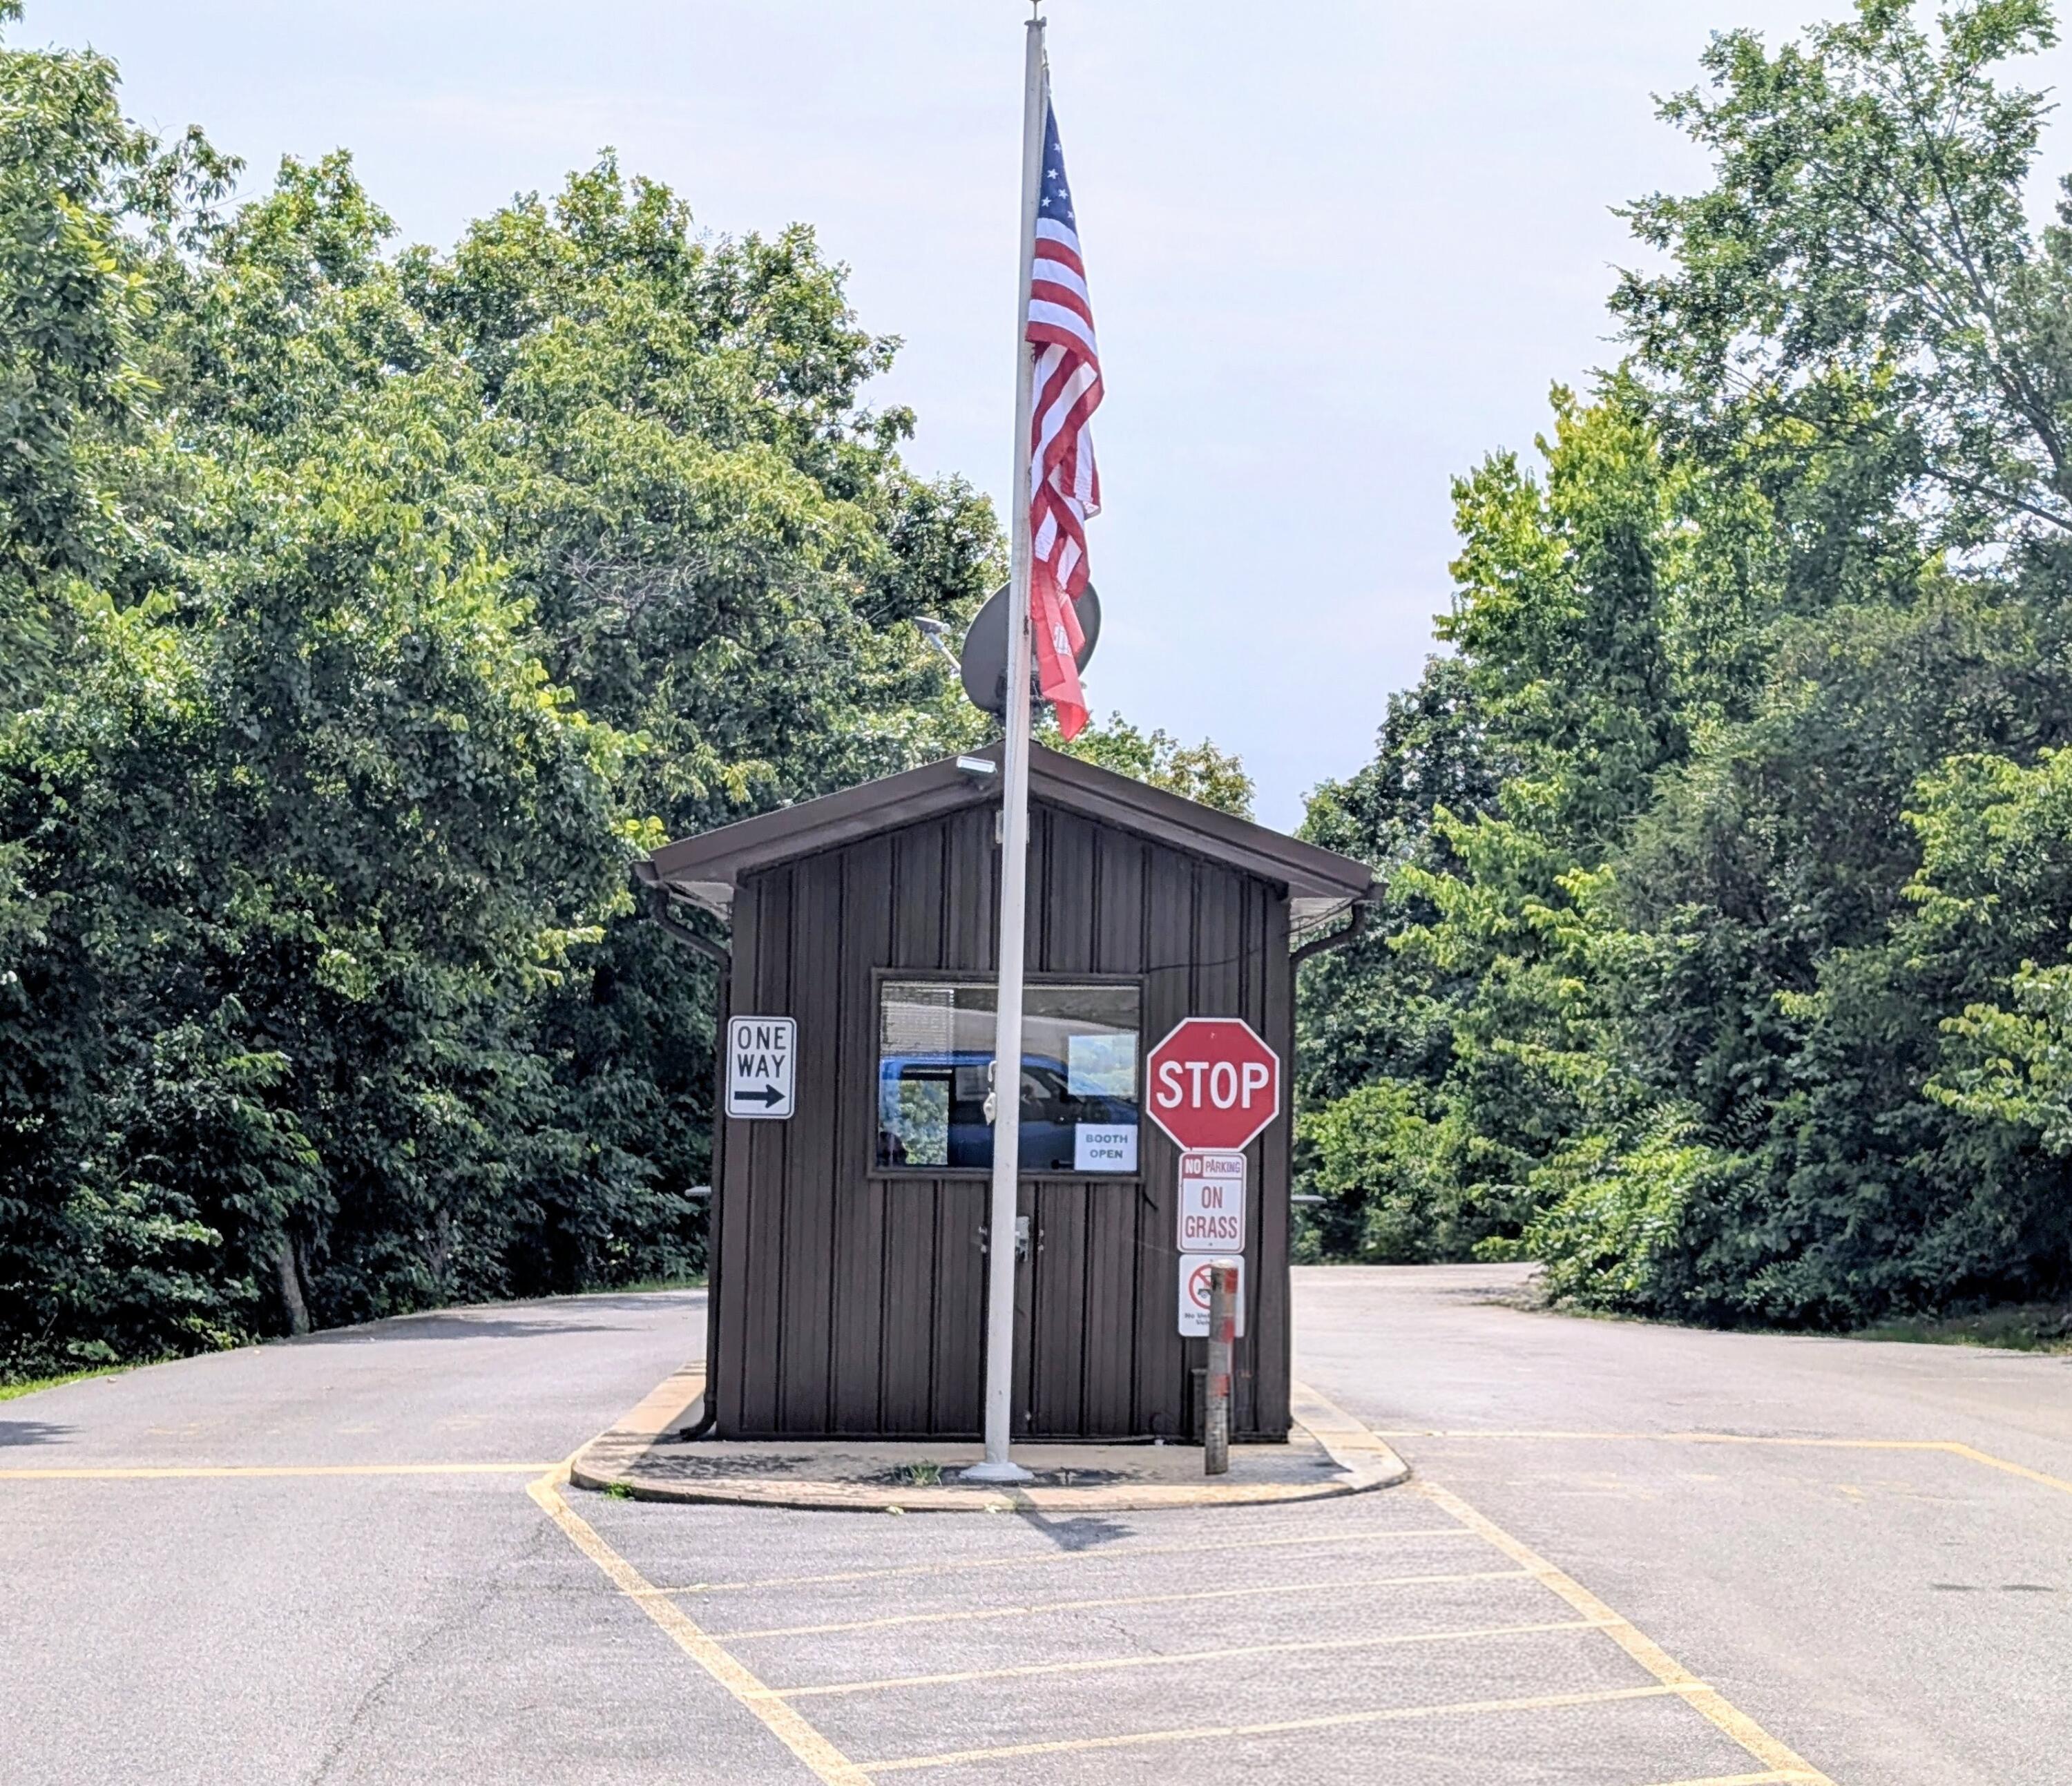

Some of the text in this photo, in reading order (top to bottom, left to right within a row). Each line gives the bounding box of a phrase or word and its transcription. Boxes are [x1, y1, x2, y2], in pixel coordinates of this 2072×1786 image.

[738, 1026, 787, 1050] ONE
[737, 1053, 785, 1078] WAY
[1156, 1060, 1269, 1109] STOP
[1086, 1134, 1128, 1144] BOOTH
[1090, 1149, 1123, 1159] OPEN
[1185, 1158, 1241, 1174] NO PARKING
[1201, 1185, 1223, 1209] ON
[1185, 1215, 1238, 1239] GRASS
